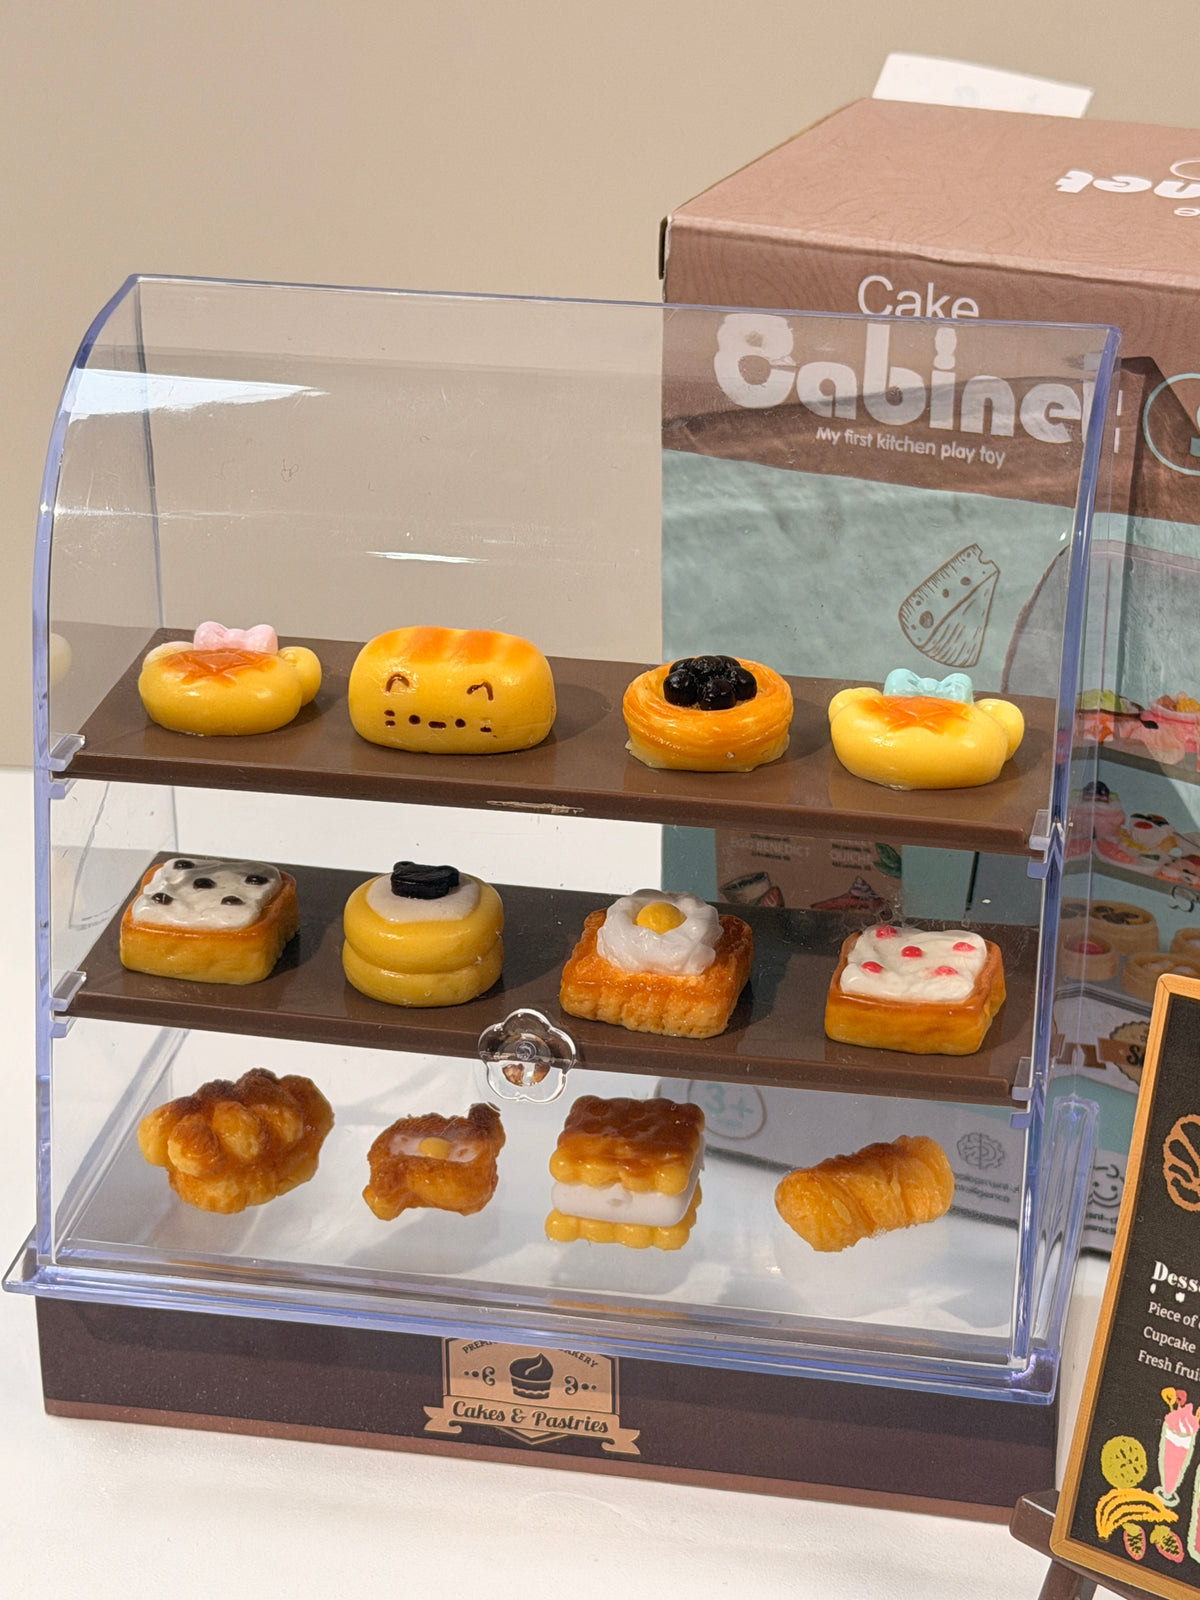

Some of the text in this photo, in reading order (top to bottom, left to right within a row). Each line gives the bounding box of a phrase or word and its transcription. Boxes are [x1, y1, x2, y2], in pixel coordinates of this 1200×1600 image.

[857, 275, 980, 319] Cake
[816, 427, 1006, 469] My first kitchen play toy
[1152, 1260, 1200, 1293] Dess
[1148, 1301, 1181, 1323] Piece
[1182, 1314, 1198, 1328] of
[1143, 1326, 1197, 1354] Cupcake
[561, 1349, 599, 1368] AKERY
[1138, 1349, 1200, 1383] Fresh frui
[452, 1400, 609, 1434] Cakes & Pastries
